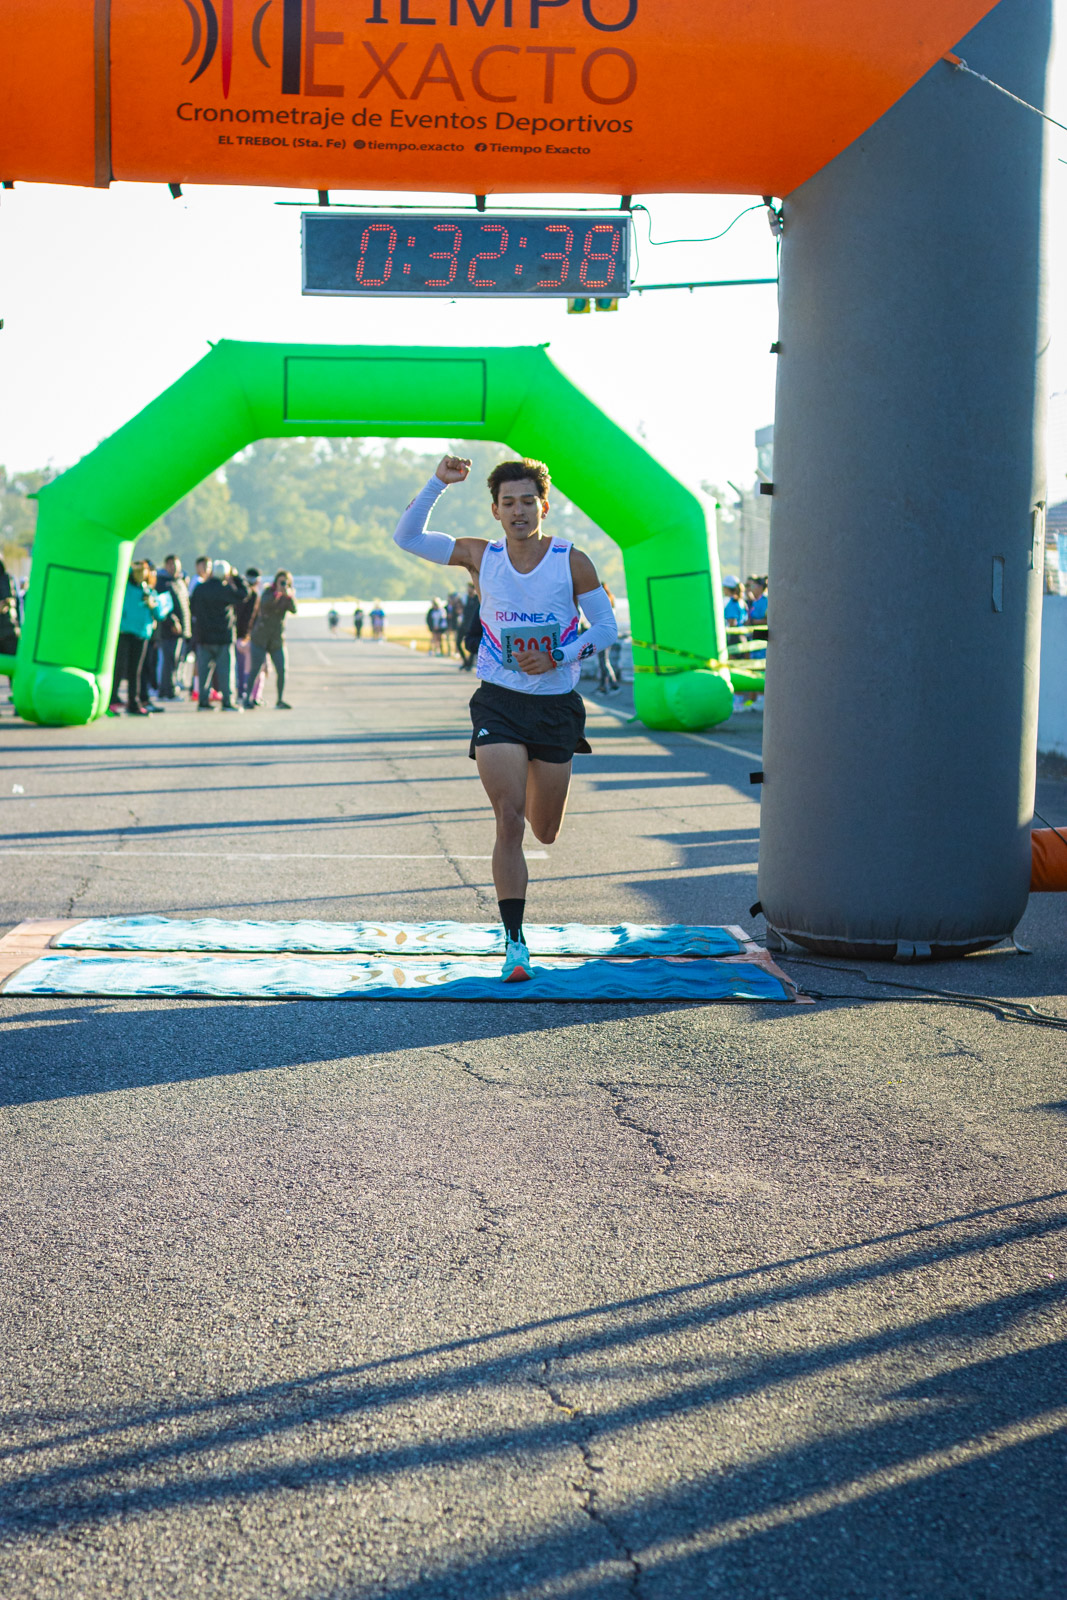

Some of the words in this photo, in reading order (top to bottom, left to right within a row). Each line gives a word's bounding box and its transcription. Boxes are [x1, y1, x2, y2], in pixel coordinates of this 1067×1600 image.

[304, 0, 638, 105] EXACTO
[176, 102, 345, 130] Cronometraje
[351, 107, 383, 127] de
[390, 109, 488, 130] Eventos
[495, 112, 634, 135] Deportivos
[218, 135, 232, 146] EL
[236, 136, 290, 147] TREBOL
[292, 138, 323, 149] (Sta.
[326, 139, 346, 150] Fe)
[368, 140, 465, 153] tiempo.exacto
[490, 143, 542, 155] Tiempo
[545, 145, 591, 155] Exacto
[355, 224, 620, 287] 0:32:38
[495, 611, 558, 623] RUNNEA
